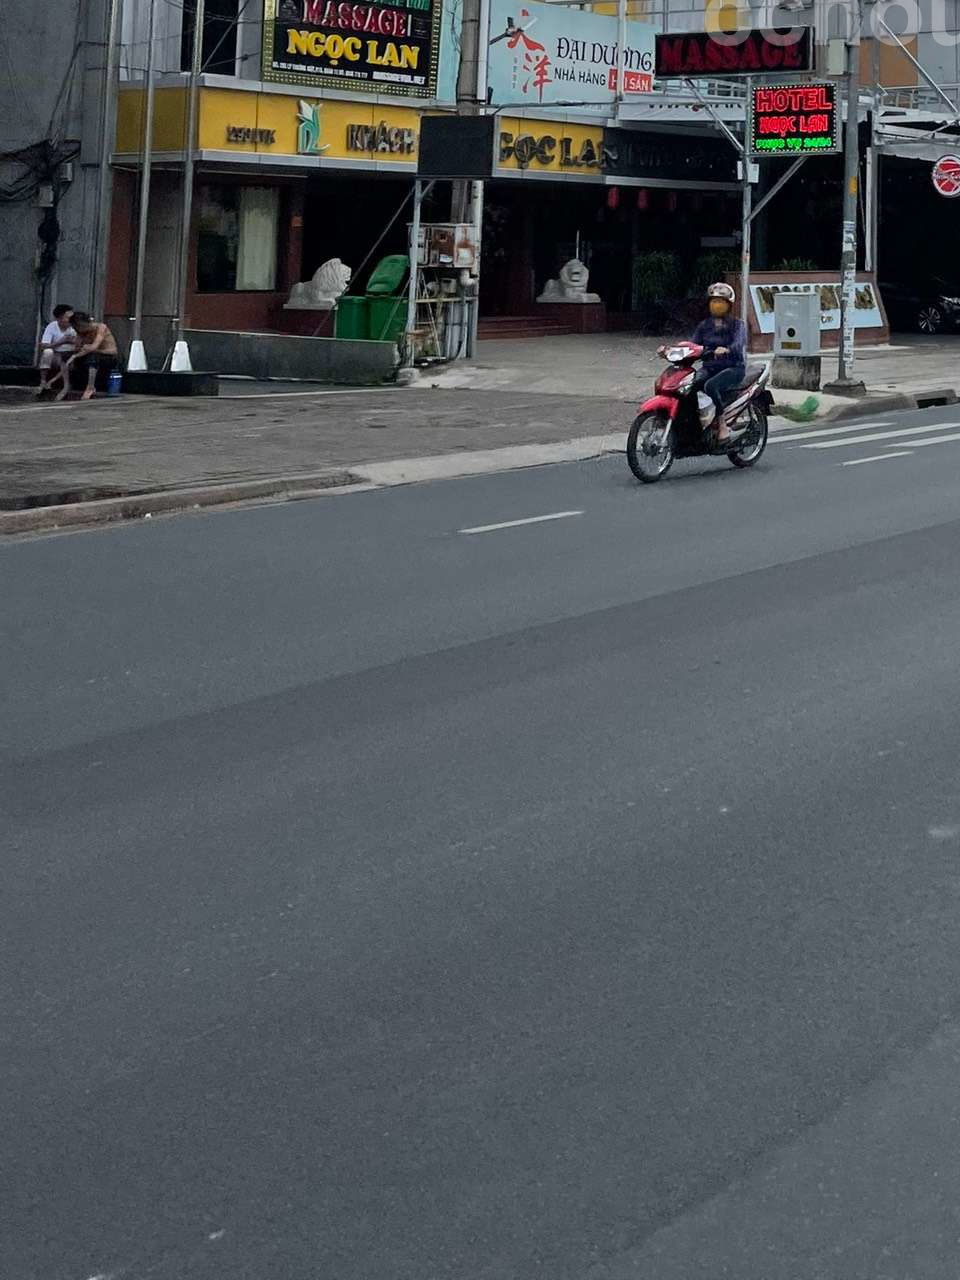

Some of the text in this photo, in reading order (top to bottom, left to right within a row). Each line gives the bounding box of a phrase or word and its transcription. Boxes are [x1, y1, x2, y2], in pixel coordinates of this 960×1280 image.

[286, 28, 362, 66] NGỌC
[365, 40, 420, 70] LAN
[557, 36, 586, 64] ĐẠI
[659, 35, 801, 70] MASSAGE
[756, 88, 833, 112] HOTEL
